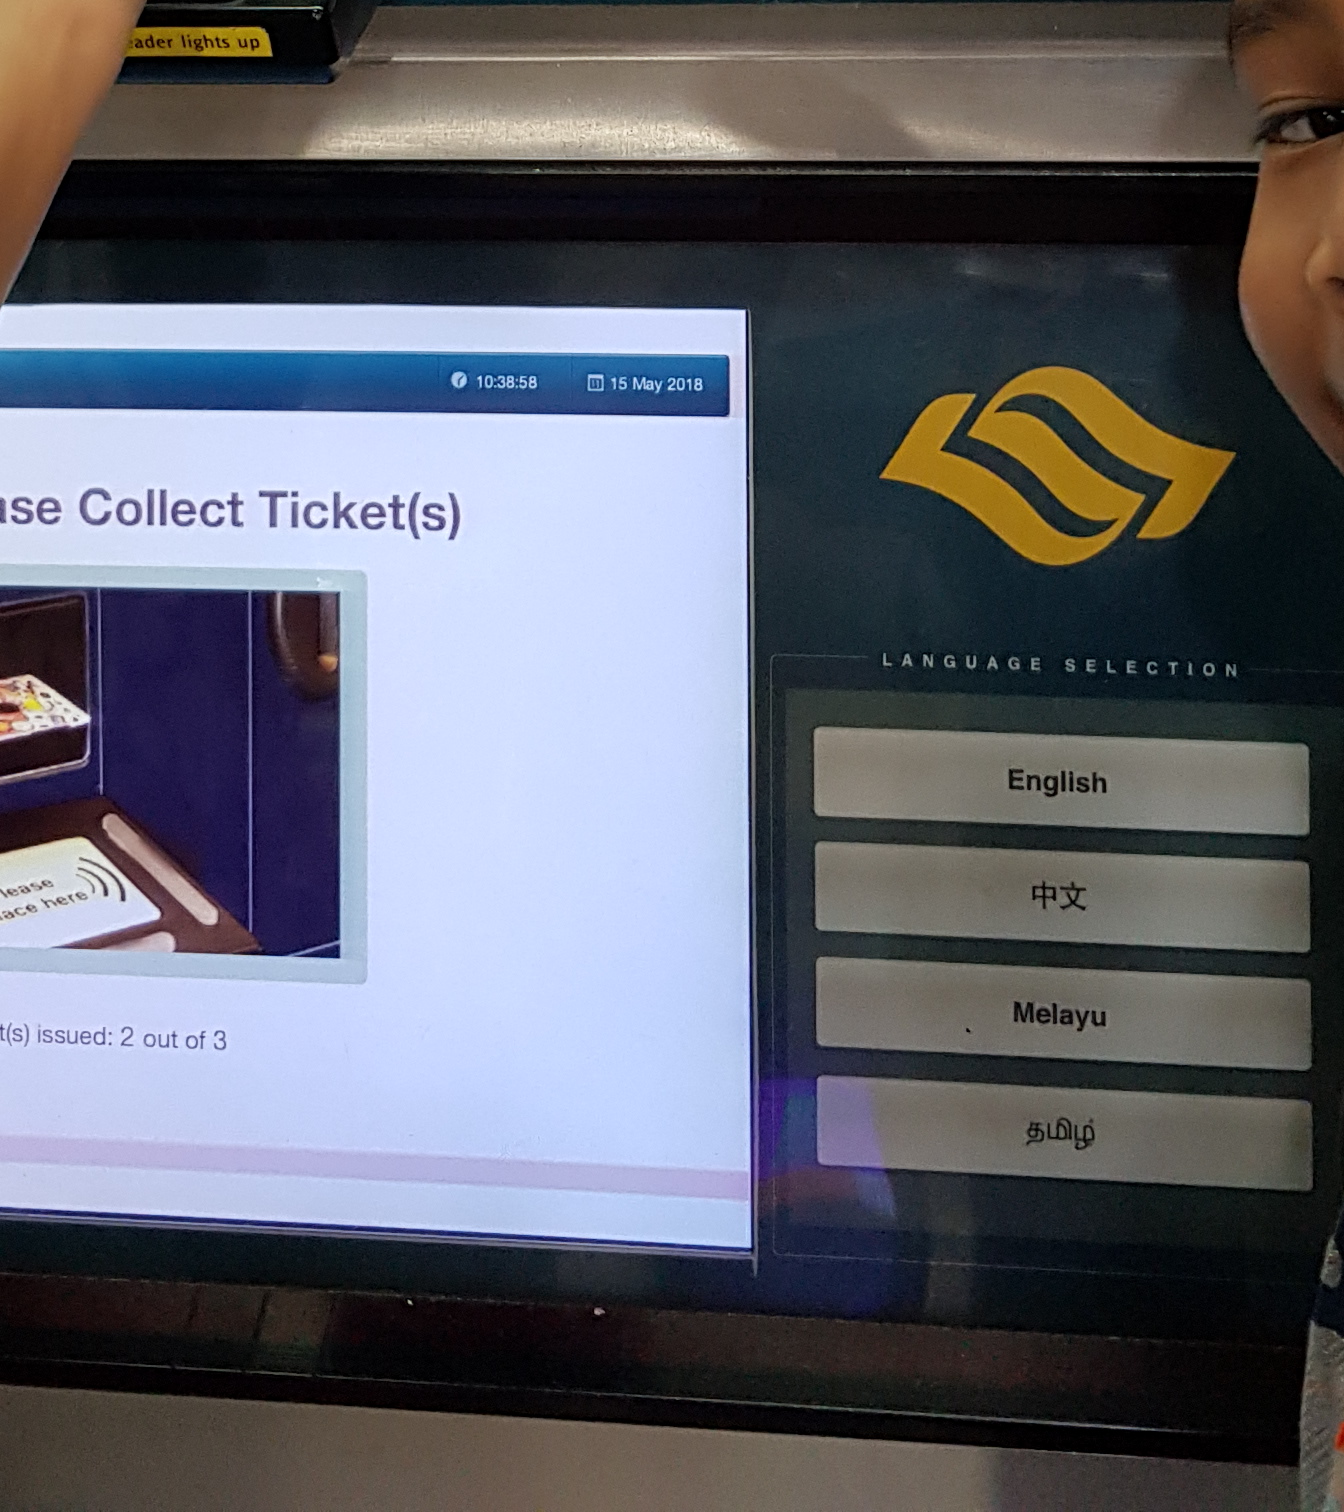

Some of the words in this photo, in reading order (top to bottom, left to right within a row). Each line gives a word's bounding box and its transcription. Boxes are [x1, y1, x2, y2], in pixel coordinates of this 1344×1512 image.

[181, 34, 230, 52] lights
[237, 38, 260, 52] up
[476, 374, 538, 389] 10:38:58
[610, 377, 628, 390] 15
[632, 377, 663, 394] May
[667, 377, 703, 392] 2018
[79, 487, 244, 528] Collect
[258, 491, 461, 540] Ticket(s)
[881, 653, 1042, 671] LANGUAGE
[1064, 657, 1238, 678] SELECTION
[1008, 768, 1108, 798] English
[41, 889, 89, 910] here
[1031, 880, 1087, 911] 中文
[1013, 1000, 1107, 1032] Melayu
[37, 1023, 112, 1047] issued:
[120, 1026, 134, 1047] 2
[143, 1030, 179, 1050] out
[185, 1030, 207, 1051] of
[213, 1030, 228, 1051] 3
[1025, 1116, 1096, 1150] தமிழ்
